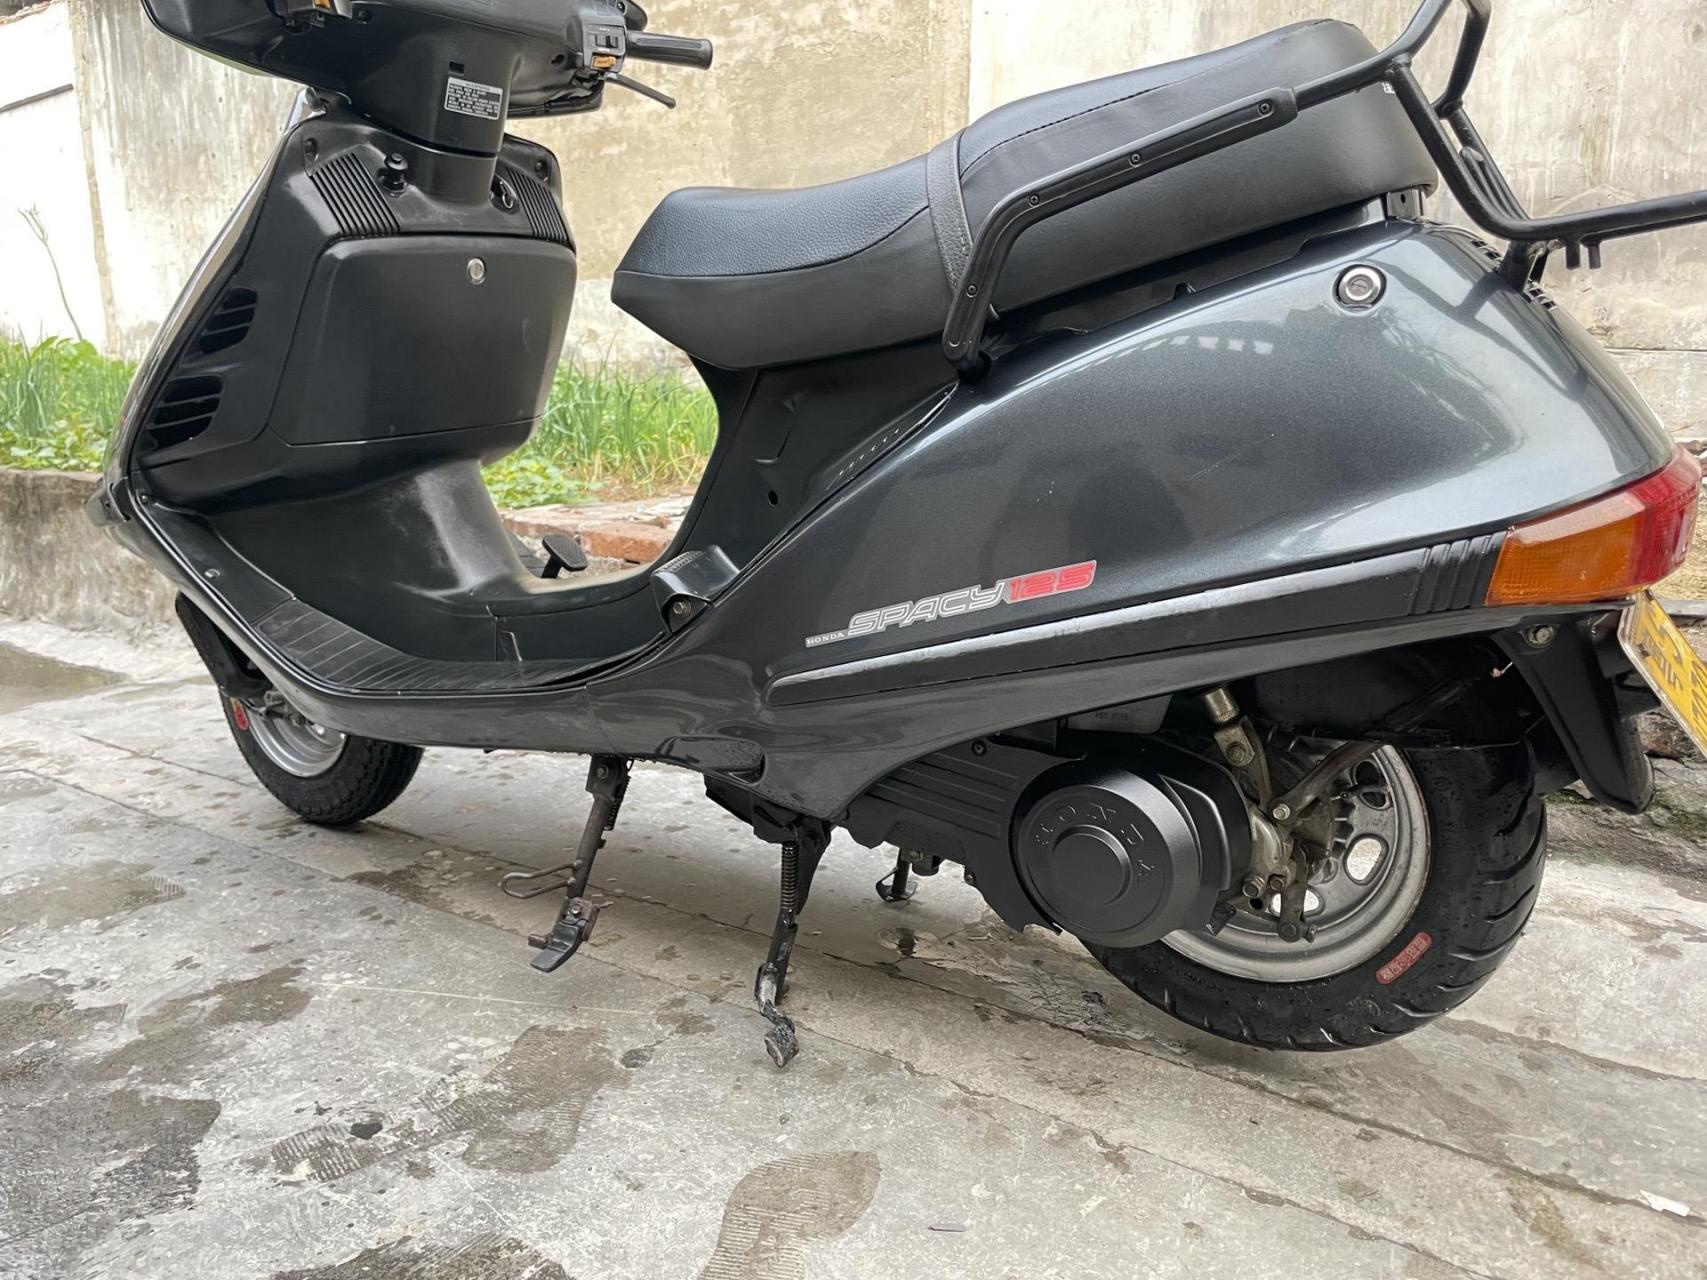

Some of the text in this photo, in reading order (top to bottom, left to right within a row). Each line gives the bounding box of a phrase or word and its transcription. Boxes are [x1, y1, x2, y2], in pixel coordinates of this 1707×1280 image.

[806, 562, 1095, 645] HONDA SPACY 125
